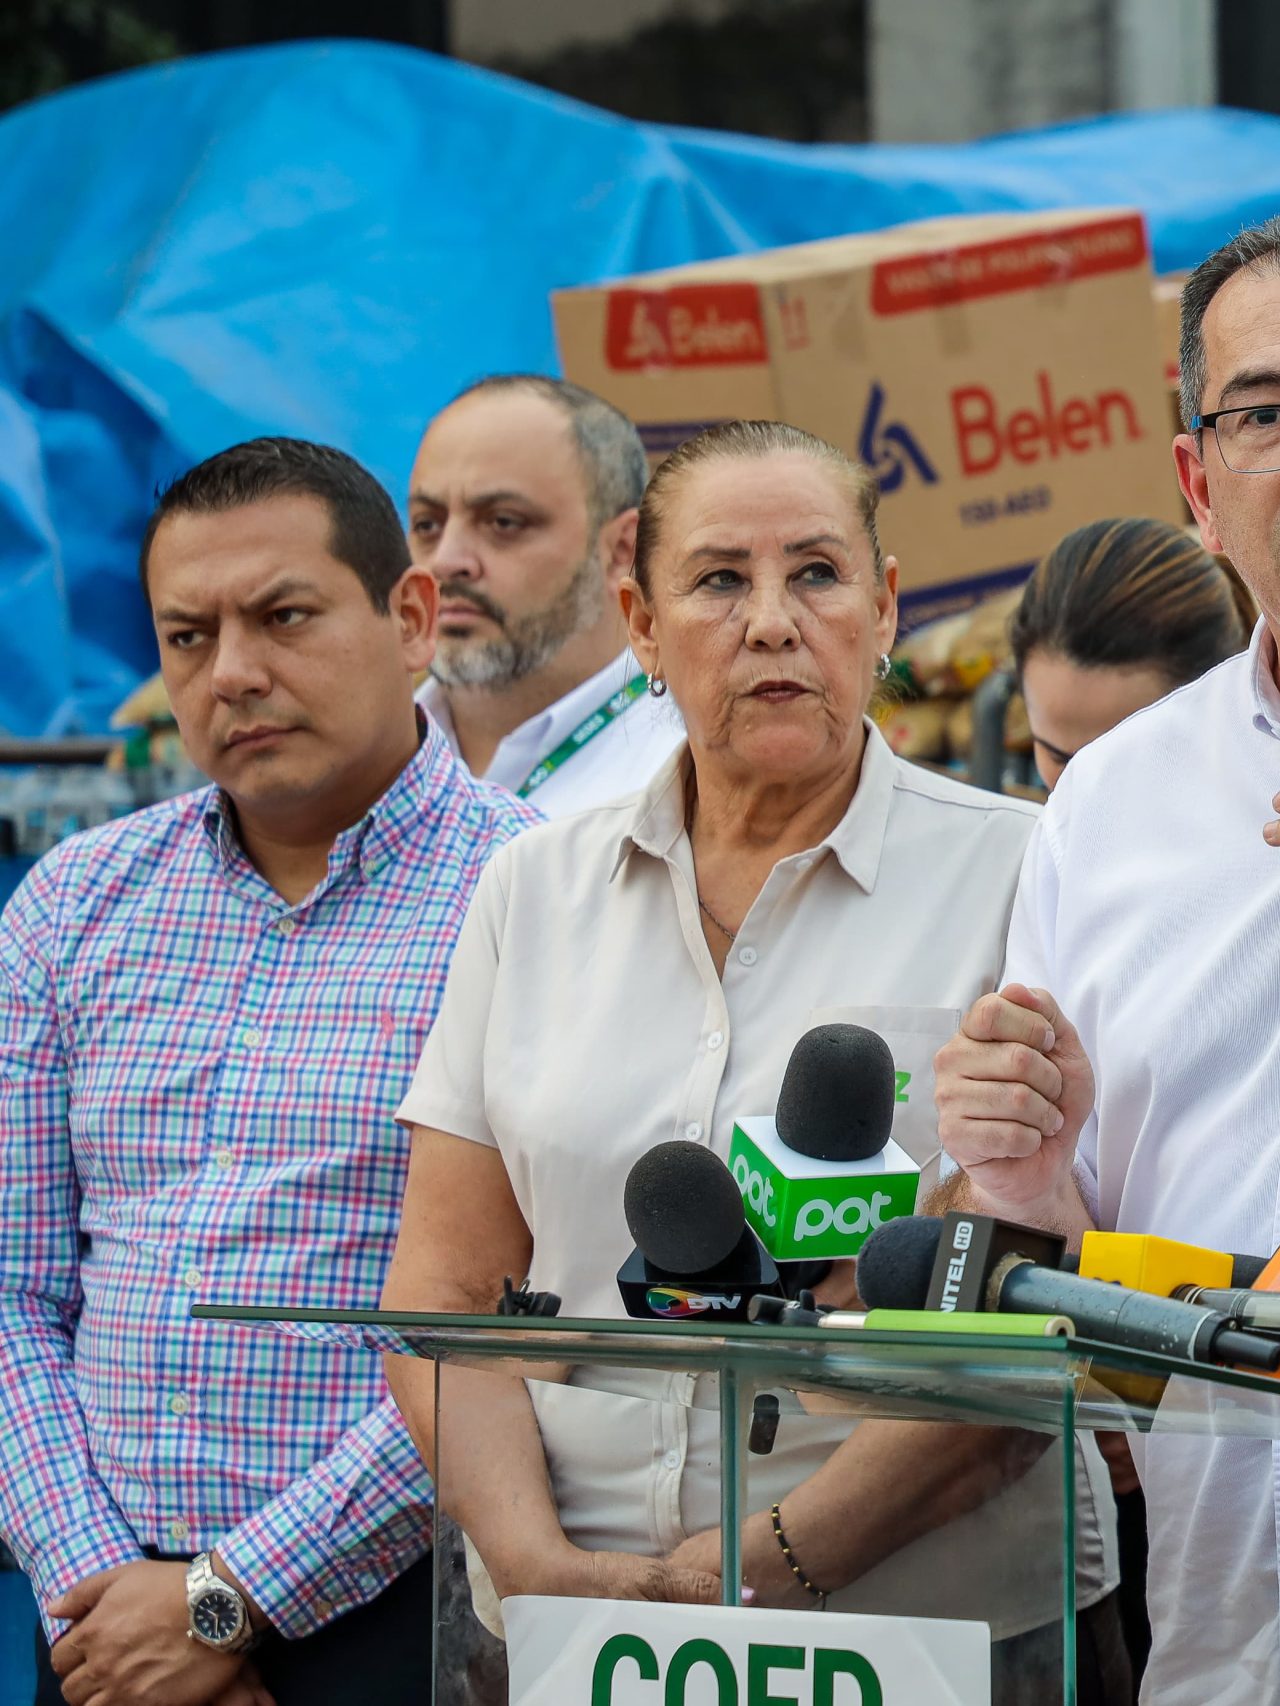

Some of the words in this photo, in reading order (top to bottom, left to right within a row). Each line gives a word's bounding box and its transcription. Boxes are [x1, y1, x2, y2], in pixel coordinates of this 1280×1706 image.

[669, 304, 761, 356] Belen
[951, 368, 1142, 477] Belen
[733, 1154, 776, 1227] pat
[794, 1191, 892, 1241] pat
